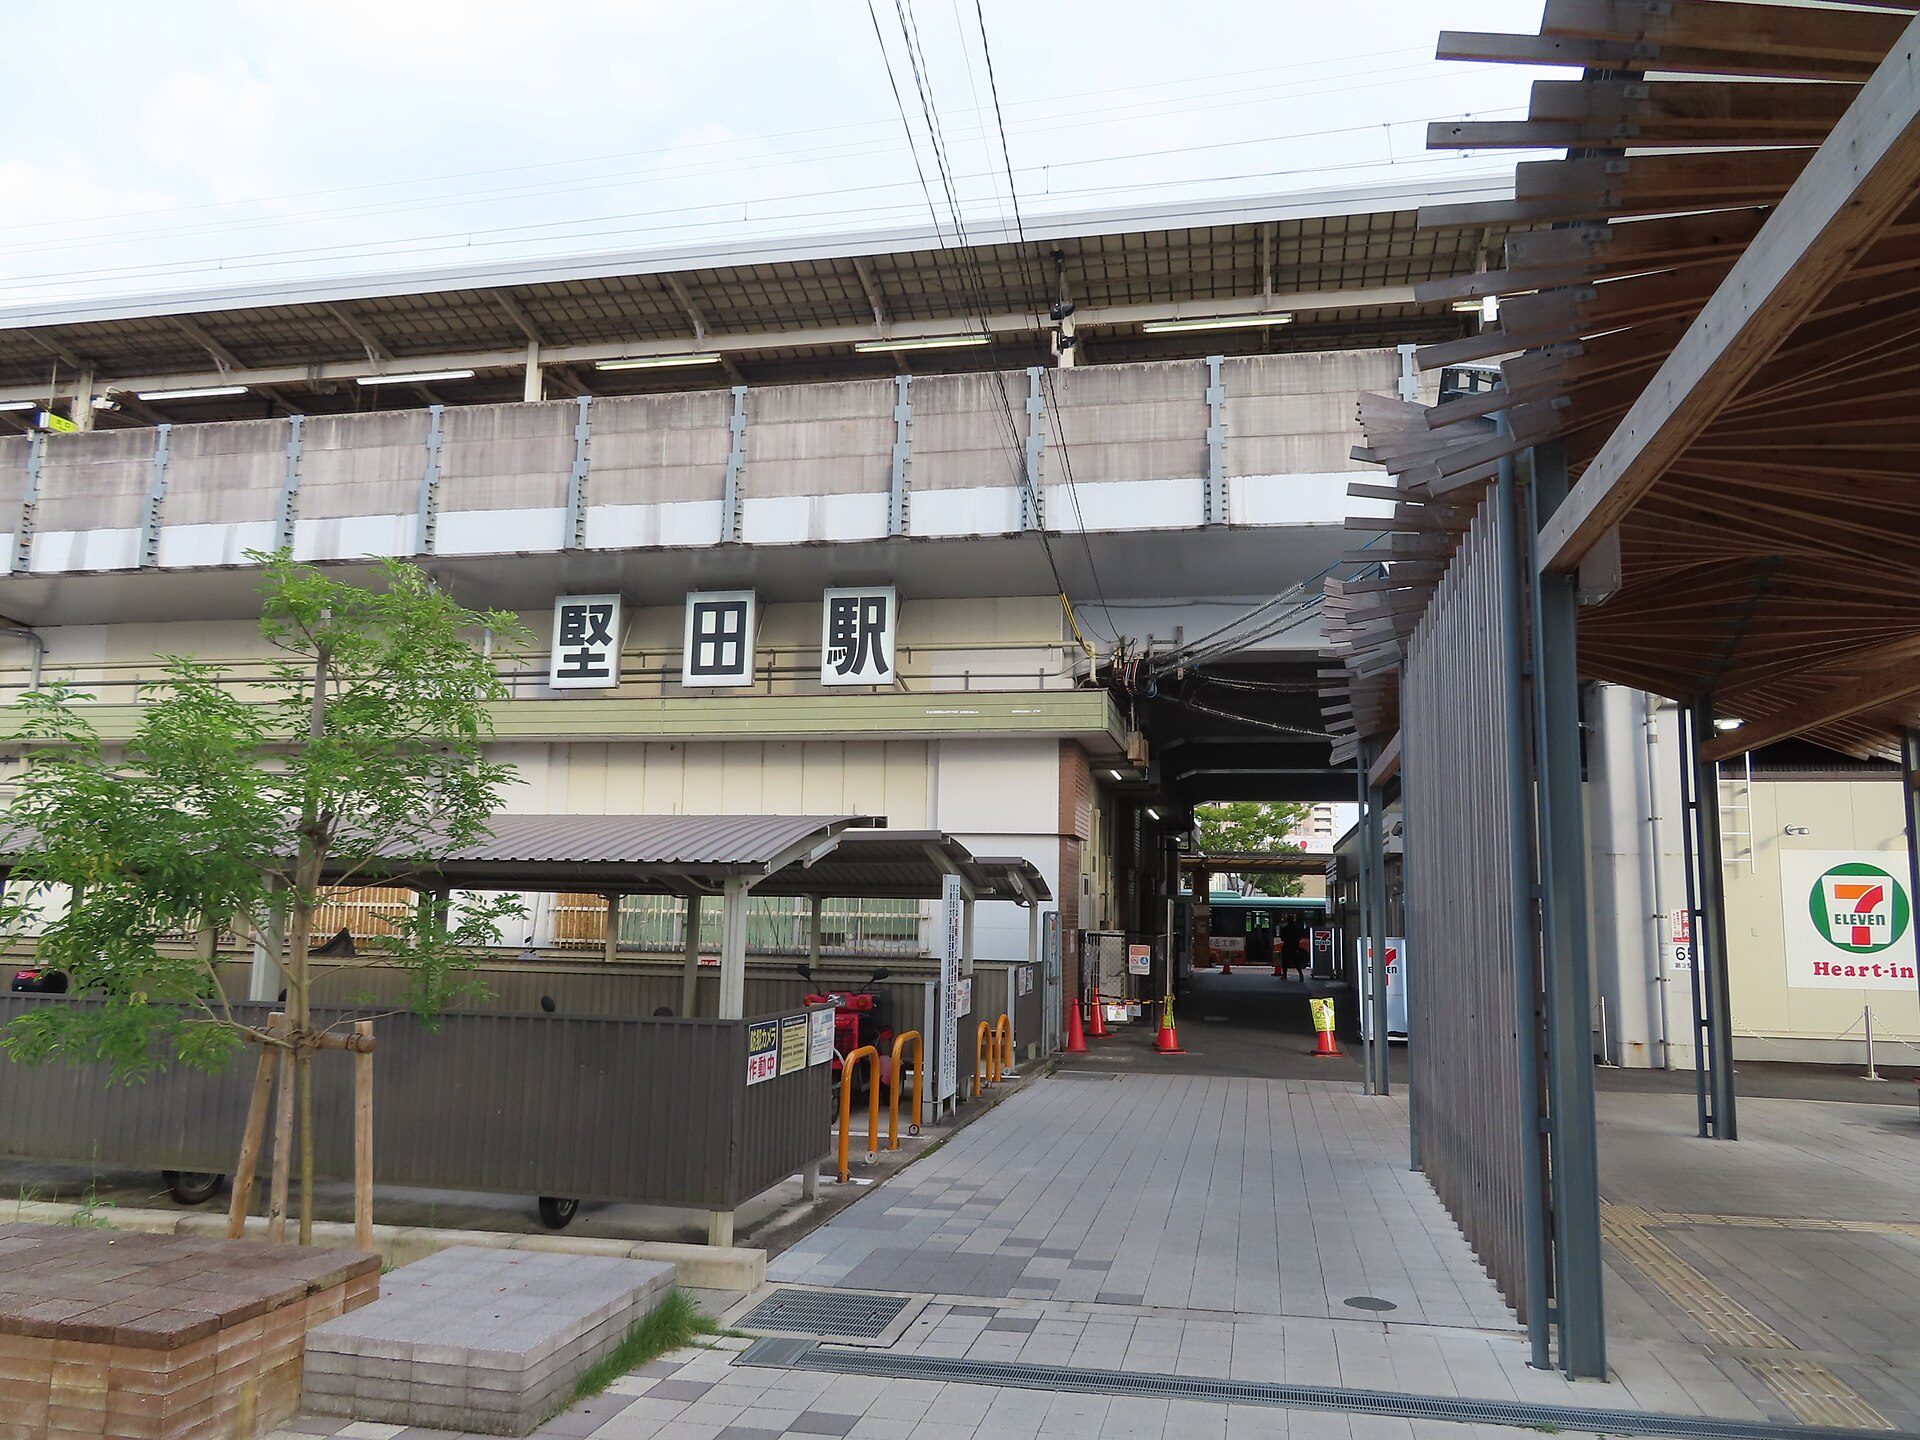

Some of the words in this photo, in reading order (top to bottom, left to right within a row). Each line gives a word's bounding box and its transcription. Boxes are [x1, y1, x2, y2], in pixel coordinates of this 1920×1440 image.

[557, 597, 889, 678] 堅田駅
[1834, 884, 1884, 945] 7
[1813, 961, 1915, 979] Heart-in
[750, 1027, 777, 1052] 防犯カメラ
[749, 1054, 775, 1081] 作動中
